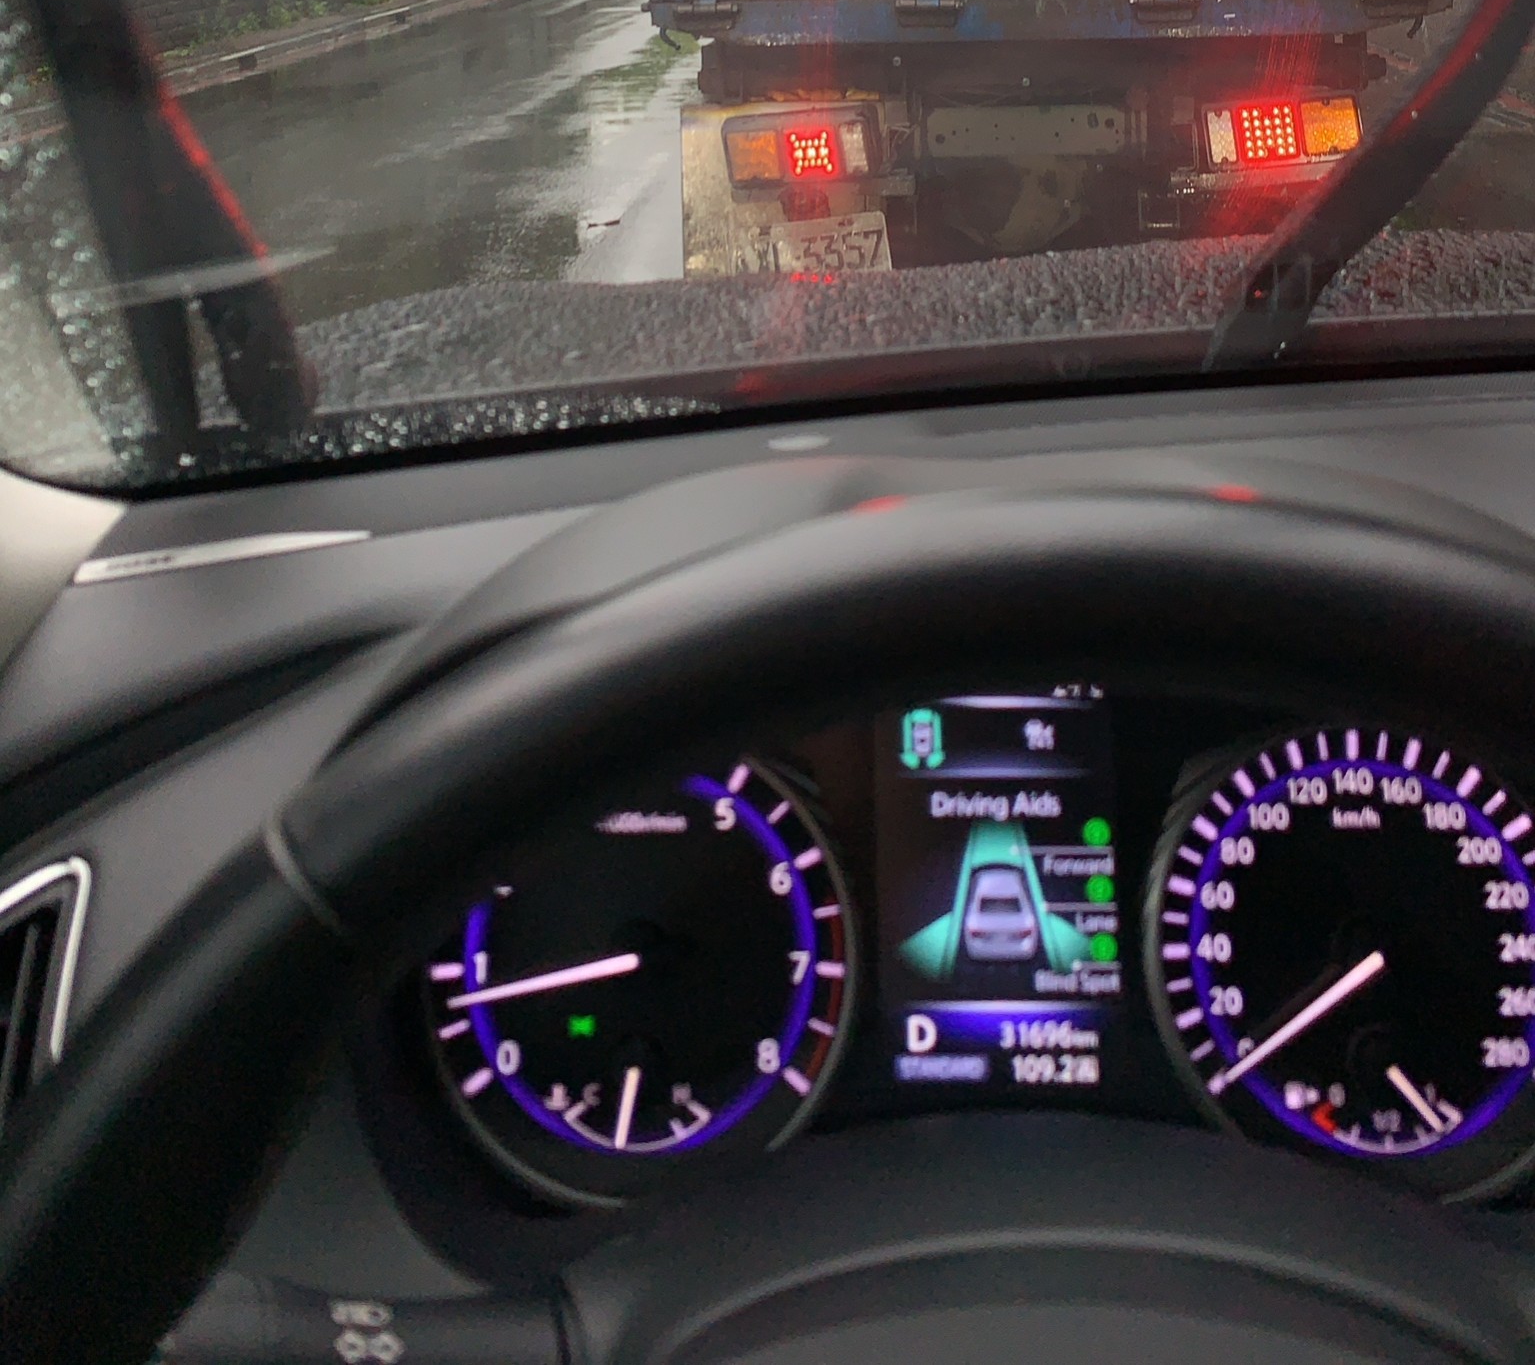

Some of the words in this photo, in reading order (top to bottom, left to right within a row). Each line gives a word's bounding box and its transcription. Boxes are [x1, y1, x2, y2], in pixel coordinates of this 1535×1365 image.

[1287, 777, 1327, 805] 120
[1332, 767, 1373, 795] 140
[1381, 777, 1421, 805] 160
[714, 798, 735, 830] 5
[931, 791, 1010, 822] Driving
[1012, 791, 1062, 817] Aids
[1248, 803, 1289, 831] 100
[1332, 806, 1381, 829] km/h
[1424, 803, 1465, 831] 180
[1220, 836, 1254, 864] 80
[1457, 835, 1502, 864] 200
[769, 862, 792, 895] 6
[1201, 881, 1234, 910] 60
[1484, 881, 1530, 910] 220
[1197, 933, 1232, 963] 40
[472, 950, 488, 984] 1
[788, 950, 811, 985] 7
[1210, 986, 1243, 1015] 20
[907, 1014, 937, 1053] D
[496, 1039, 521, 1075] 0
[757, 1037, 781, 1073] 8
[1482, 1038, 1530, 1067] 280
[1328, 1083, 1346, 1108] 0
